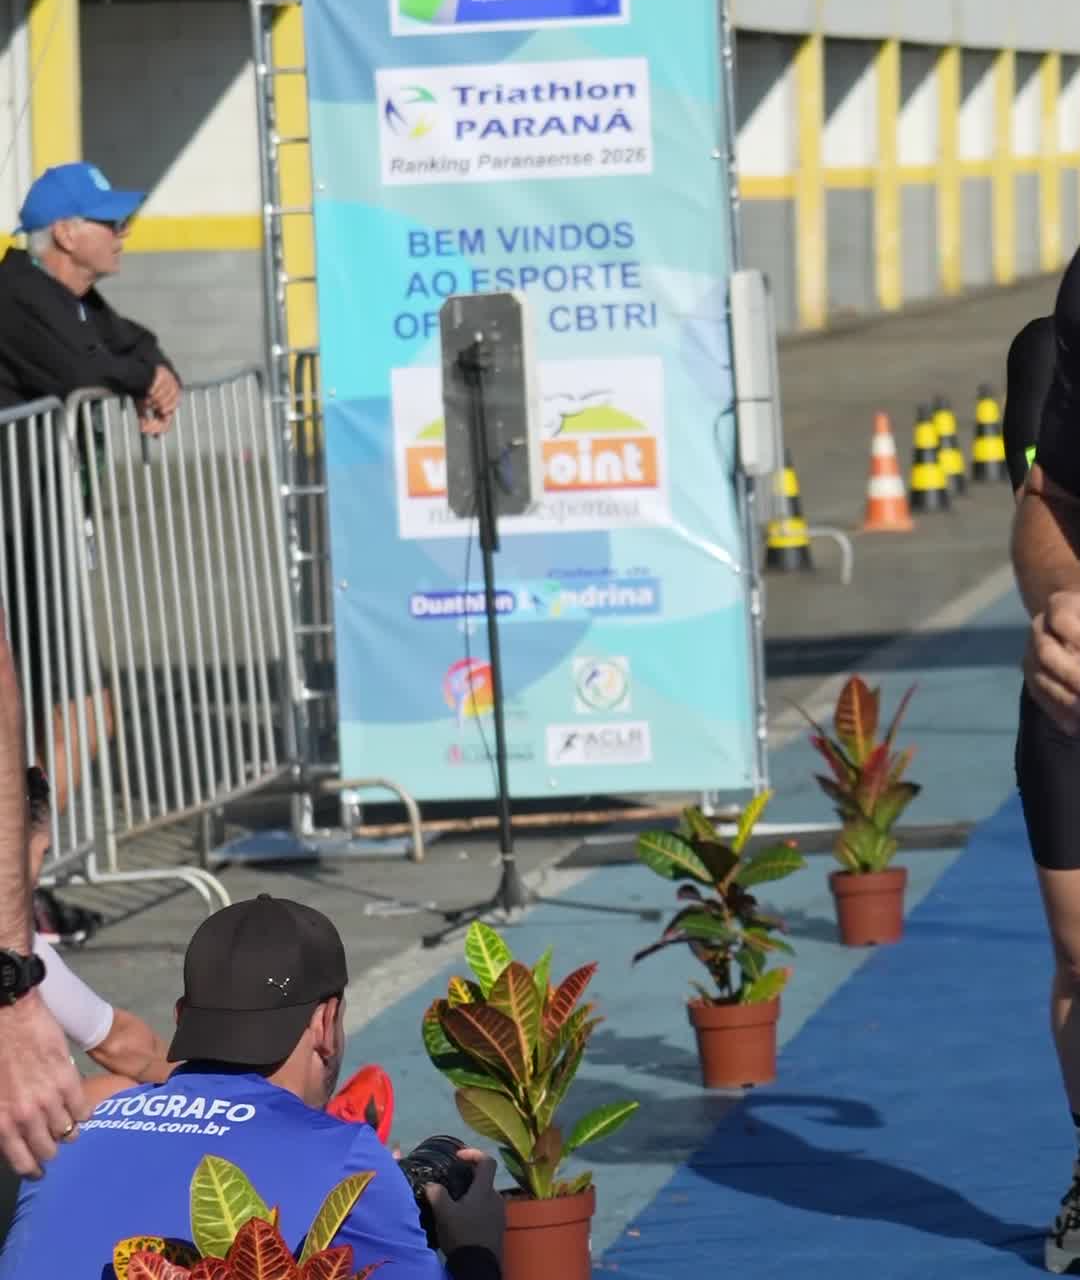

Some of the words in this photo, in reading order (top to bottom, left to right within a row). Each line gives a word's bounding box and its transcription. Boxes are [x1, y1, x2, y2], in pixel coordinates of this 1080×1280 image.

[453, 79, 637, 106] Triathlon
[456, 108, 632, 140] PARANÁ
[390, 156, 470, 175] Ranking
[478, 151, 593, 170] Paranaense
[409, 227, 486, 259] BEM
[497, 221, 635, 254] VINDOS
[405, 270, 457, 300] AO
[472, 261, 642, 293] ESPORTE
[549, 303, 657, 332] CBTRI
